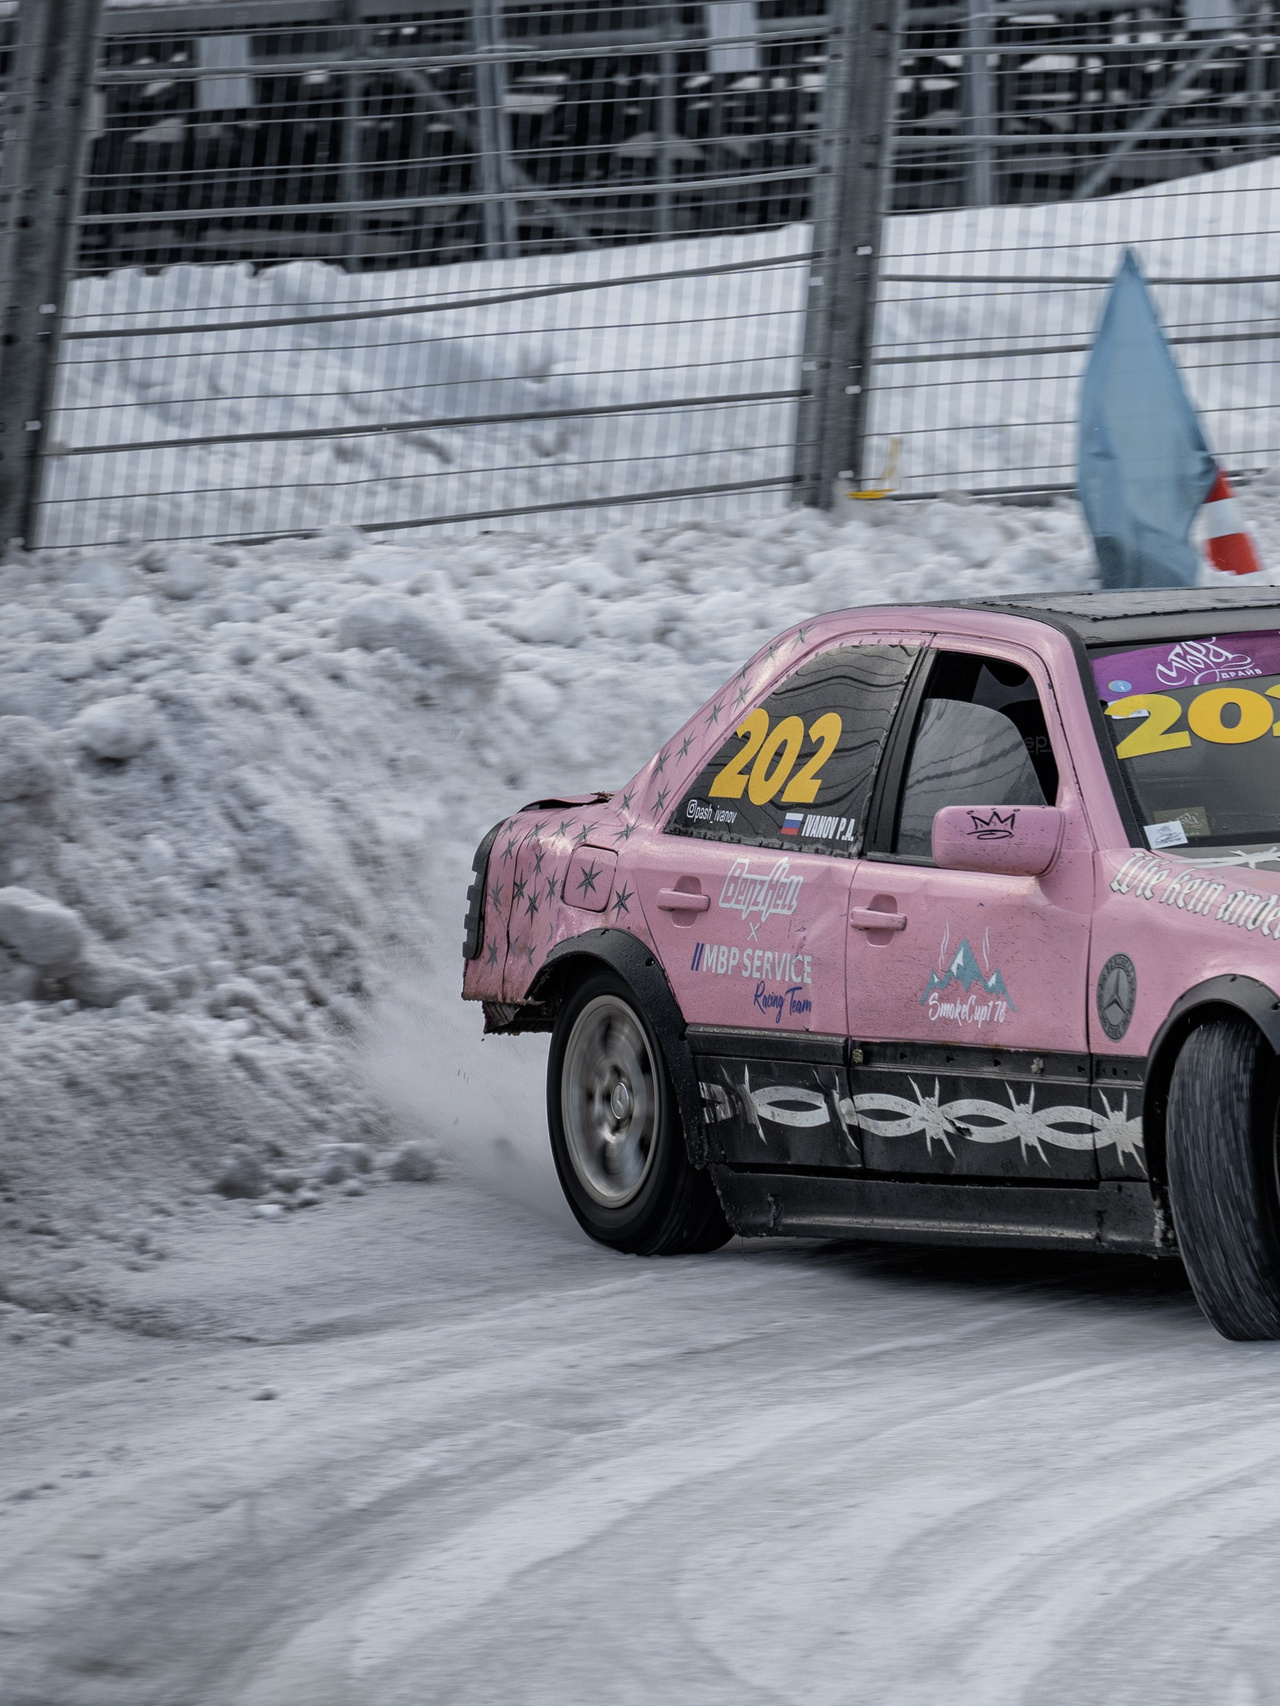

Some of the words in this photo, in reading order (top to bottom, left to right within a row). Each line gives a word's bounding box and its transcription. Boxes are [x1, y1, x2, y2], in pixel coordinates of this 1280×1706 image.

[1220, 668, 1263, 679] ДРАЙВ
[707, 707, 844, 807] 202
[801, 814, 840, 840] IVANOV
[835, 818, 857, 842] P.A.
[1110, 851, 1173, 900] Wie
[1159, 867, 1227, 917] kein
[741, 948, 813, 984] SERVICE
[753, 980, 785, 1024] Racing
[784, 986, 813, 1015] Team
